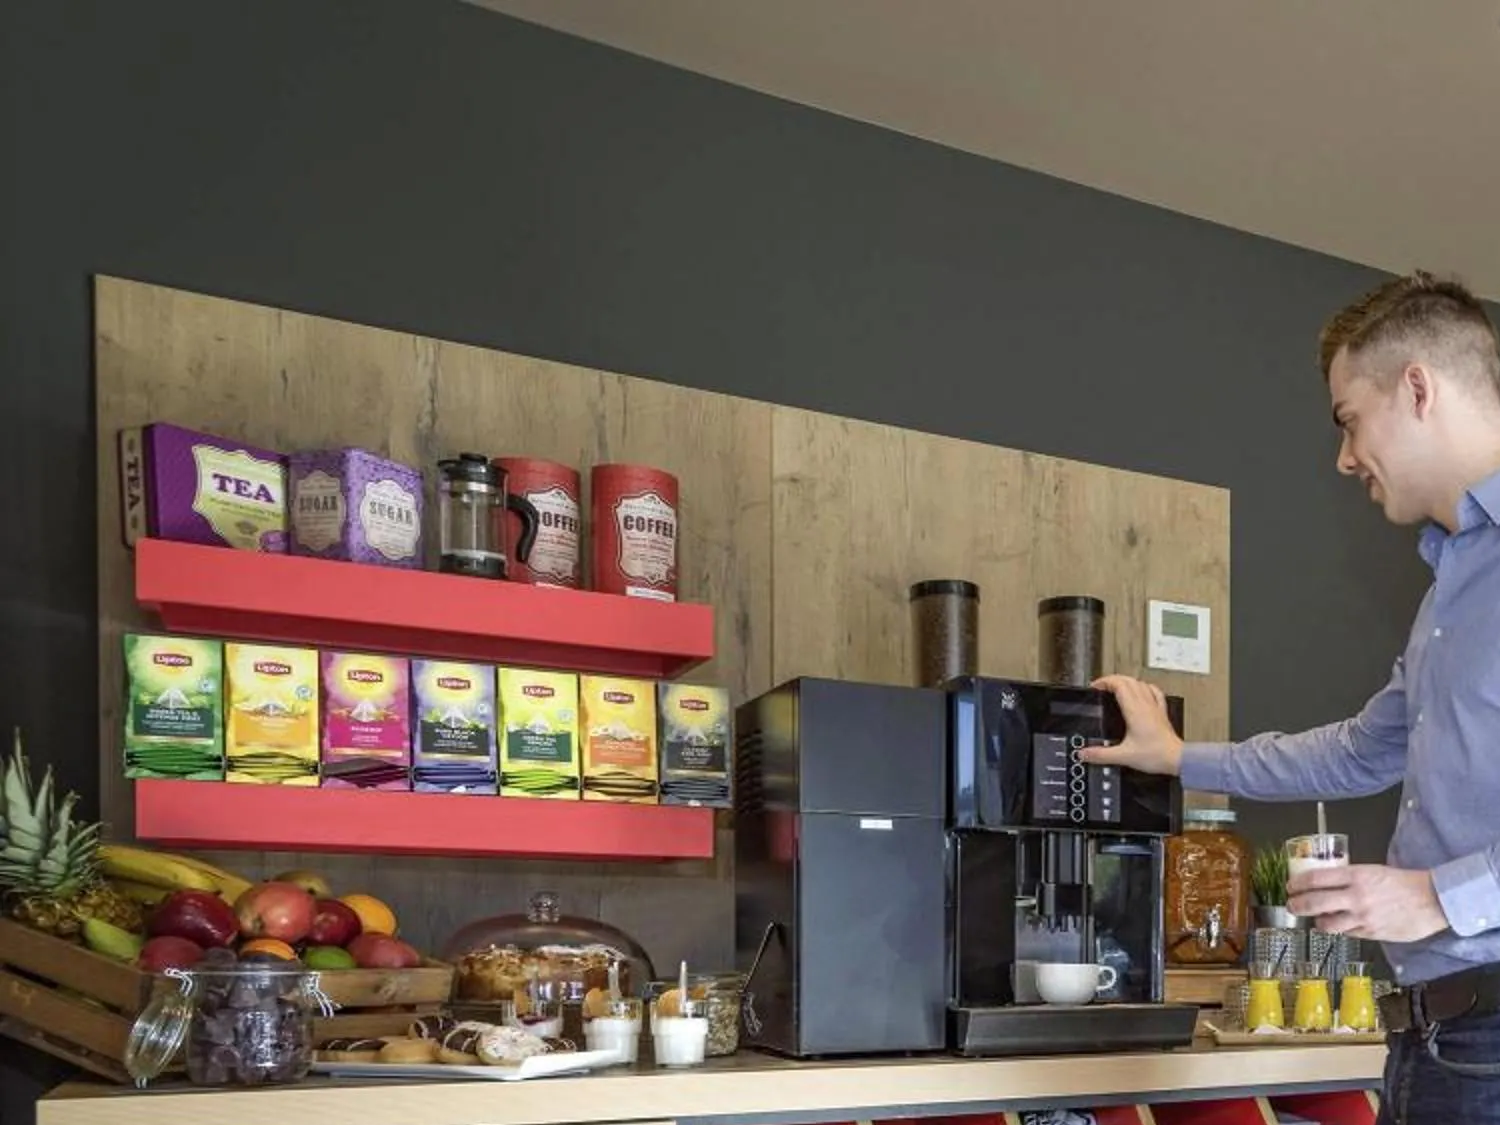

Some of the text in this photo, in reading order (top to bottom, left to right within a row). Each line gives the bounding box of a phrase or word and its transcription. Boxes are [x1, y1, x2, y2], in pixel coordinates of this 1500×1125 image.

[127, 456, 141, 511] TEA
[212, 473, 275, 503] TEA
[369, 501, 413, 525] SUGAR
[257, 664, 290, 674] Lipton
